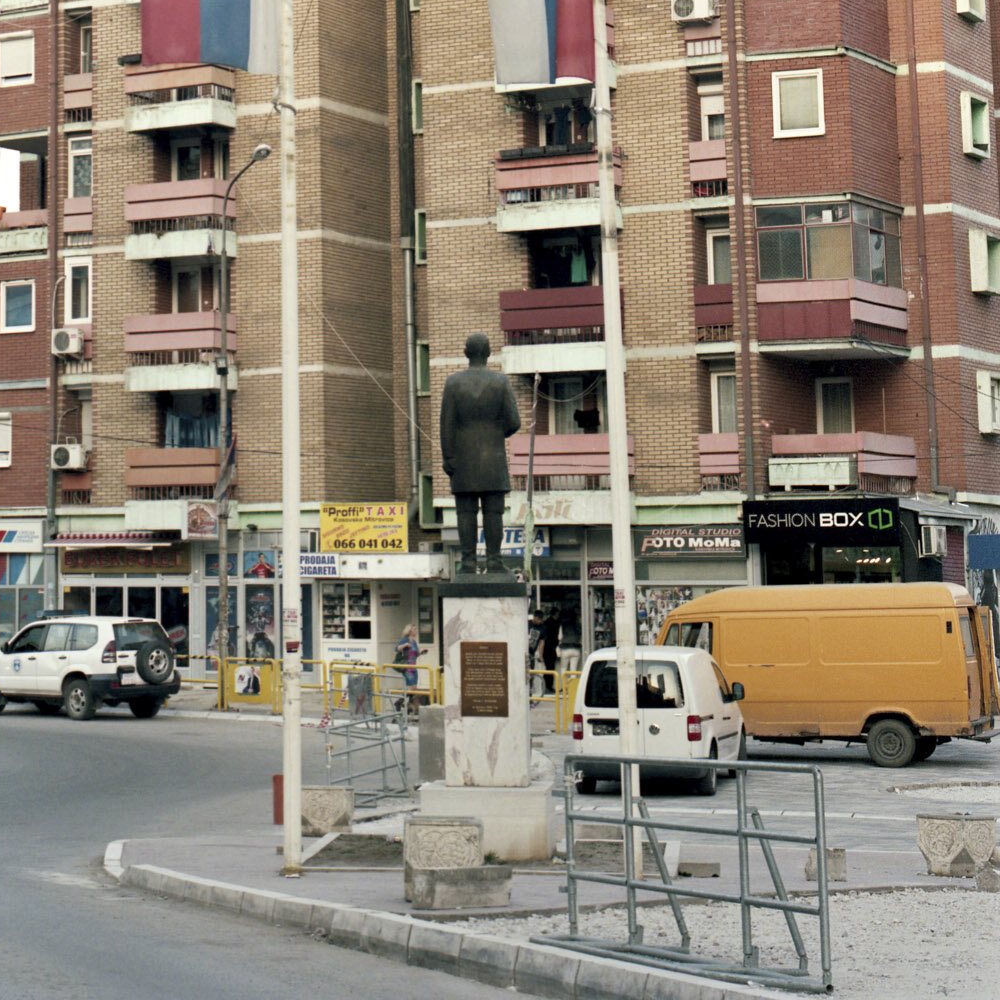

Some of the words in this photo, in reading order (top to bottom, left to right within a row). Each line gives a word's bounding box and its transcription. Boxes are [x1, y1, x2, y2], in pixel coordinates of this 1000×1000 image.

[748, 513, 816, 528] FASHION
[819, 512, 865, 527] BOX
[698, 528, 741, 536] STUDIO
[334, 538, 356, 549] 066
[358, 538, 378, 549] 041
[381, 538, 403, 549] 042
[641, 537, 686, 552] FOTO
[688, 537, 741, 548] MoMa
[64, 551, 121, 567] BUREK
[299, 555, 336, 565] PRODAJA
[299, 566, 337, 576] CIGARETA
